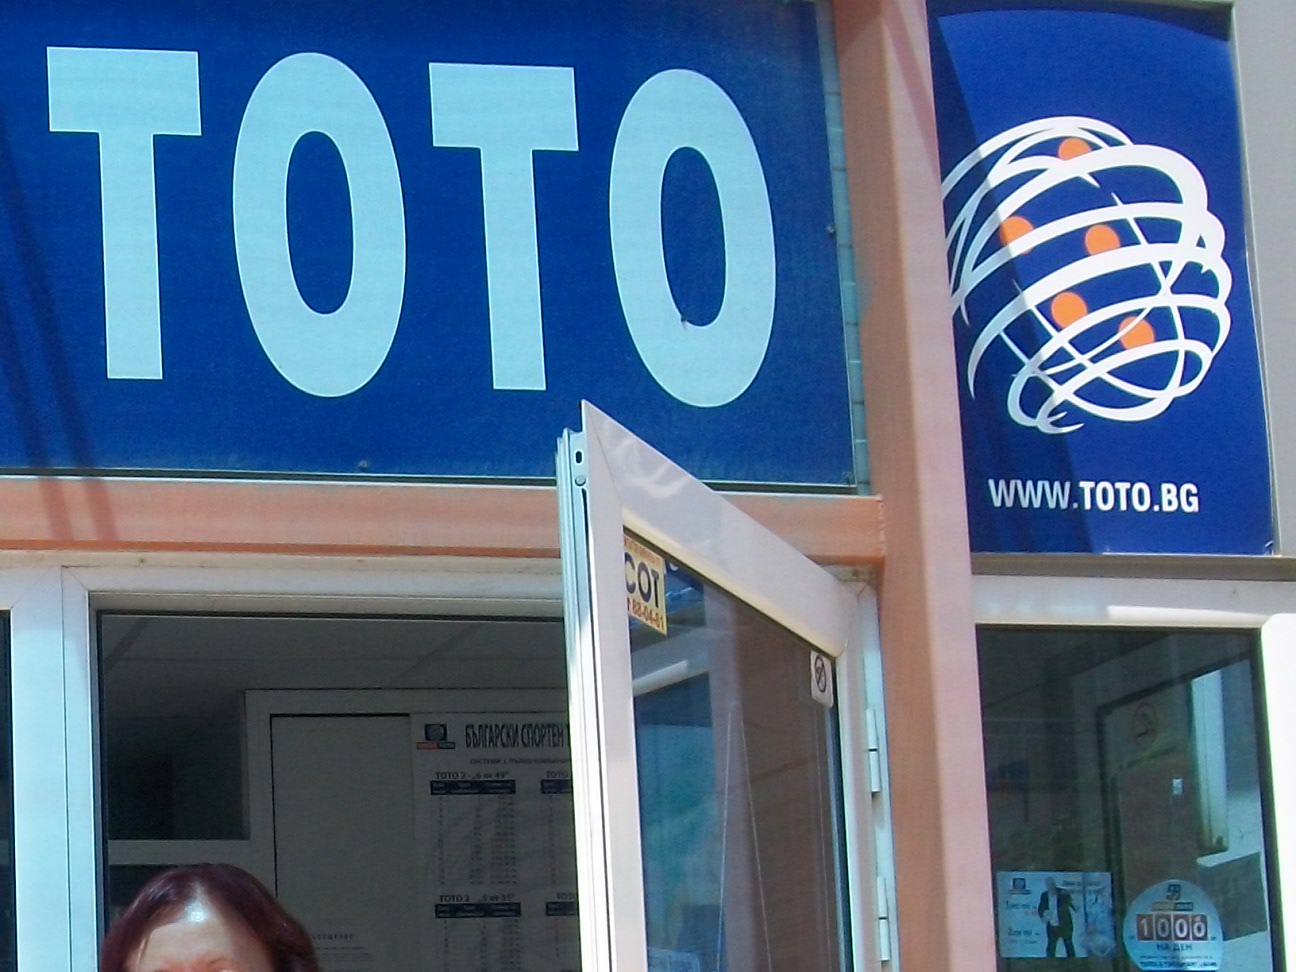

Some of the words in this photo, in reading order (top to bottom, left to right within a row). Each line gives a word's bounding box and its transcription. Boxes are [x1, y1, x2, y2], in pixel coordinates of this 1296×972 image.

[46, 46, 777, 408] ТОТО
[988, 479, 1199, 512] WWW.TOTO.BG
[465, 724, 519, 749] БЪЛГАРСКИ
[521, 724, 565, 748] СПОРТЕН
